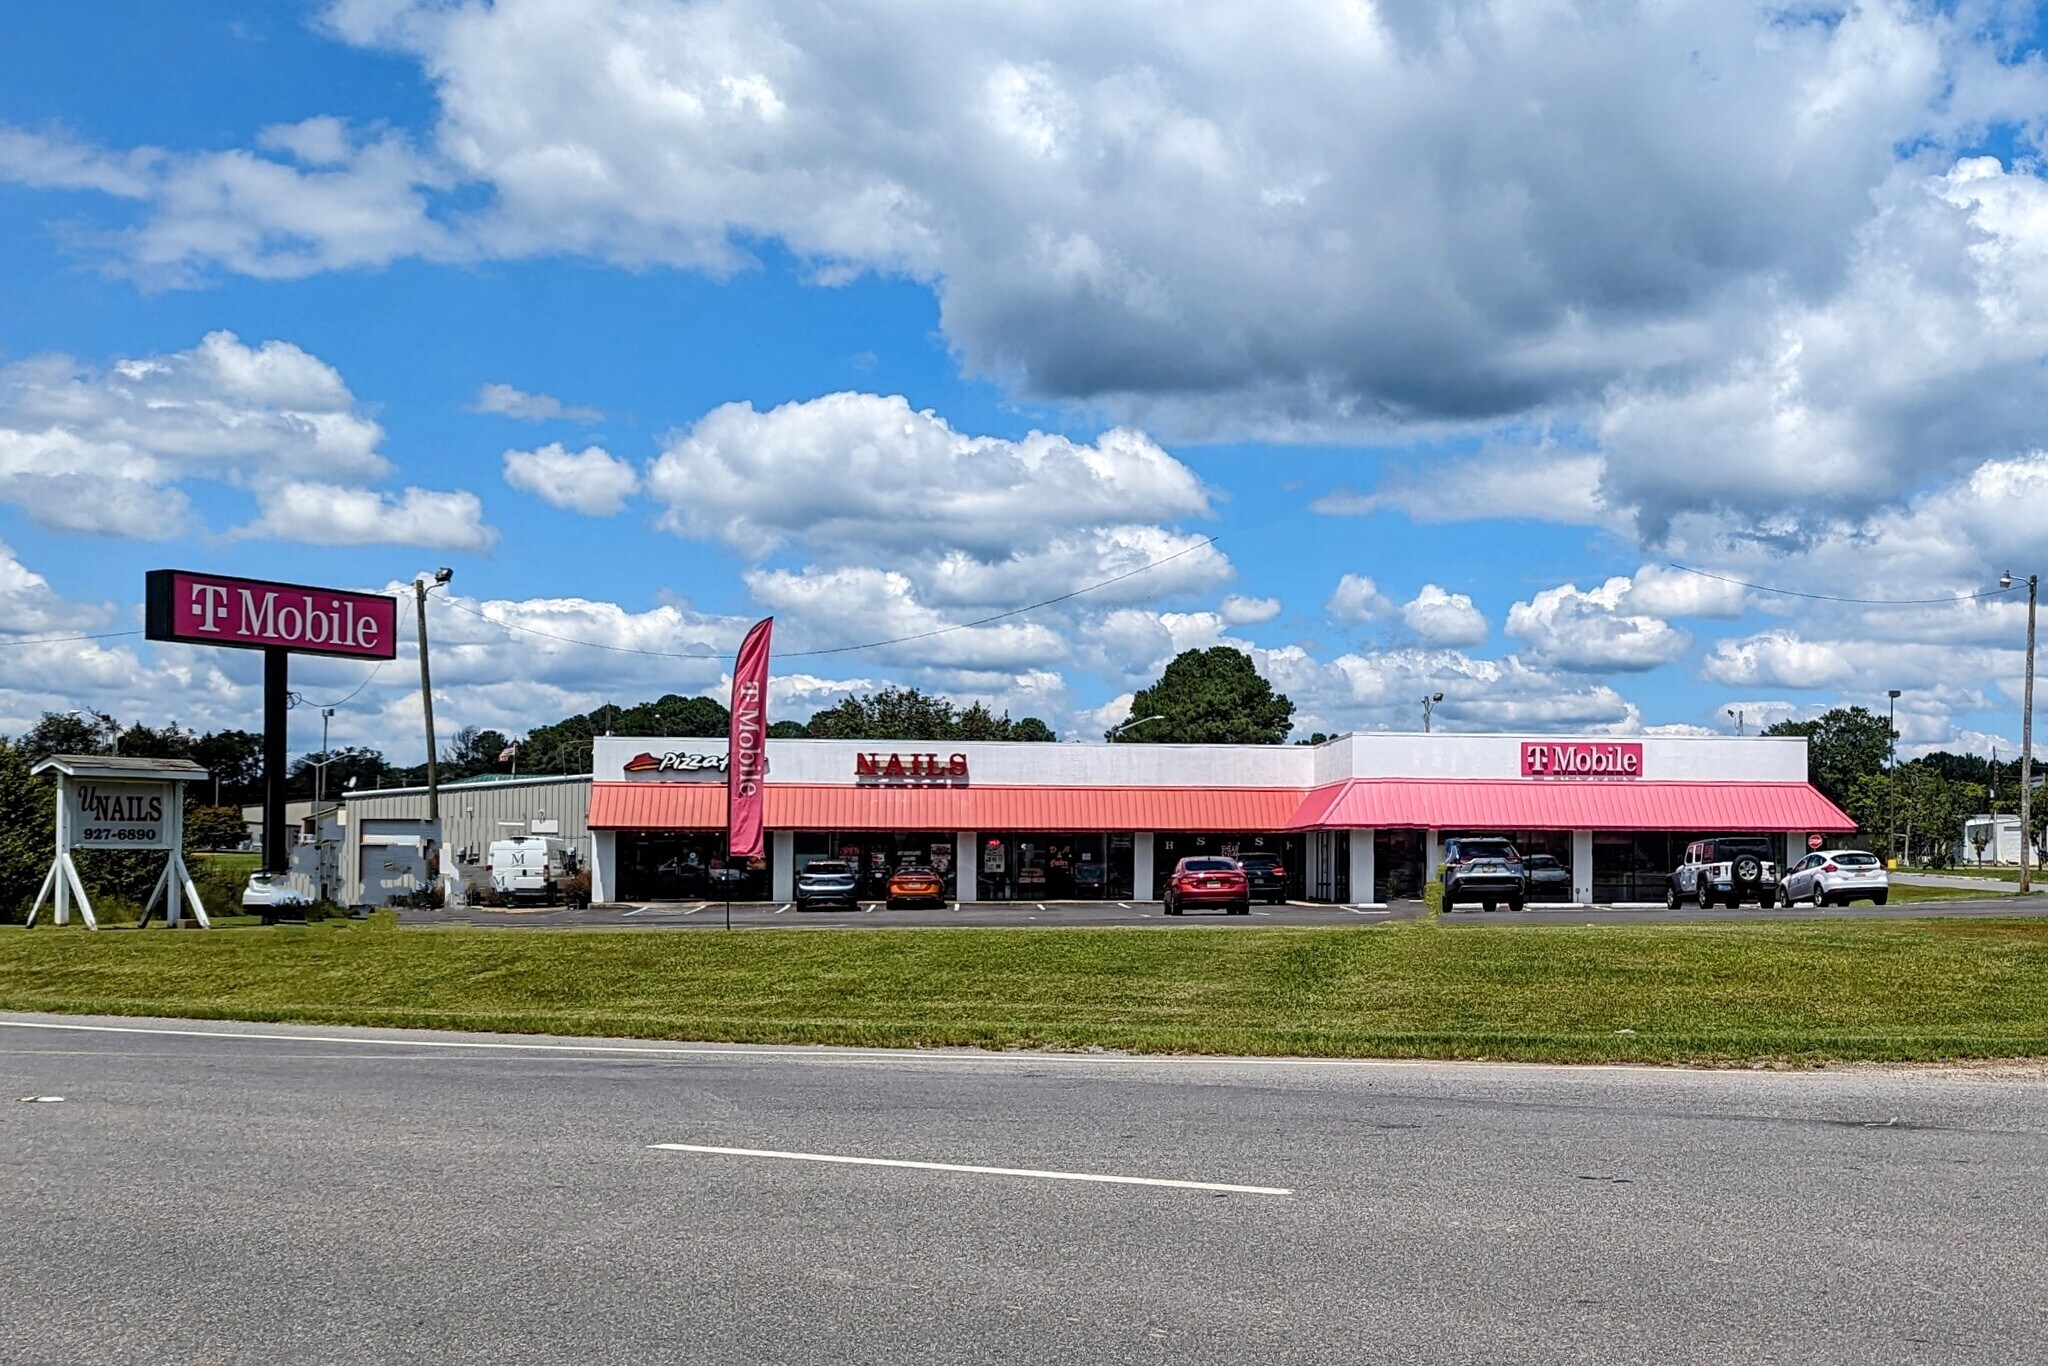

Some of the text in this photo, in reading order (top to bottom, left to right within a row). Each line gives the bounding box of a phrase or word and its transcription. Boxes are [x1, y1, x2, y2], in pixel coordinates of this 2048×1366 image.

[236, 588, 379, 649] Mobile
[738, 708, 762, 797] Mobile
[854, 753, 967, 776] NAILS
[1552, 746, 1637, 772] Mobile
[94, 795, 162, 822] NAILS
[84, 828, 156, 840] 927-6890
